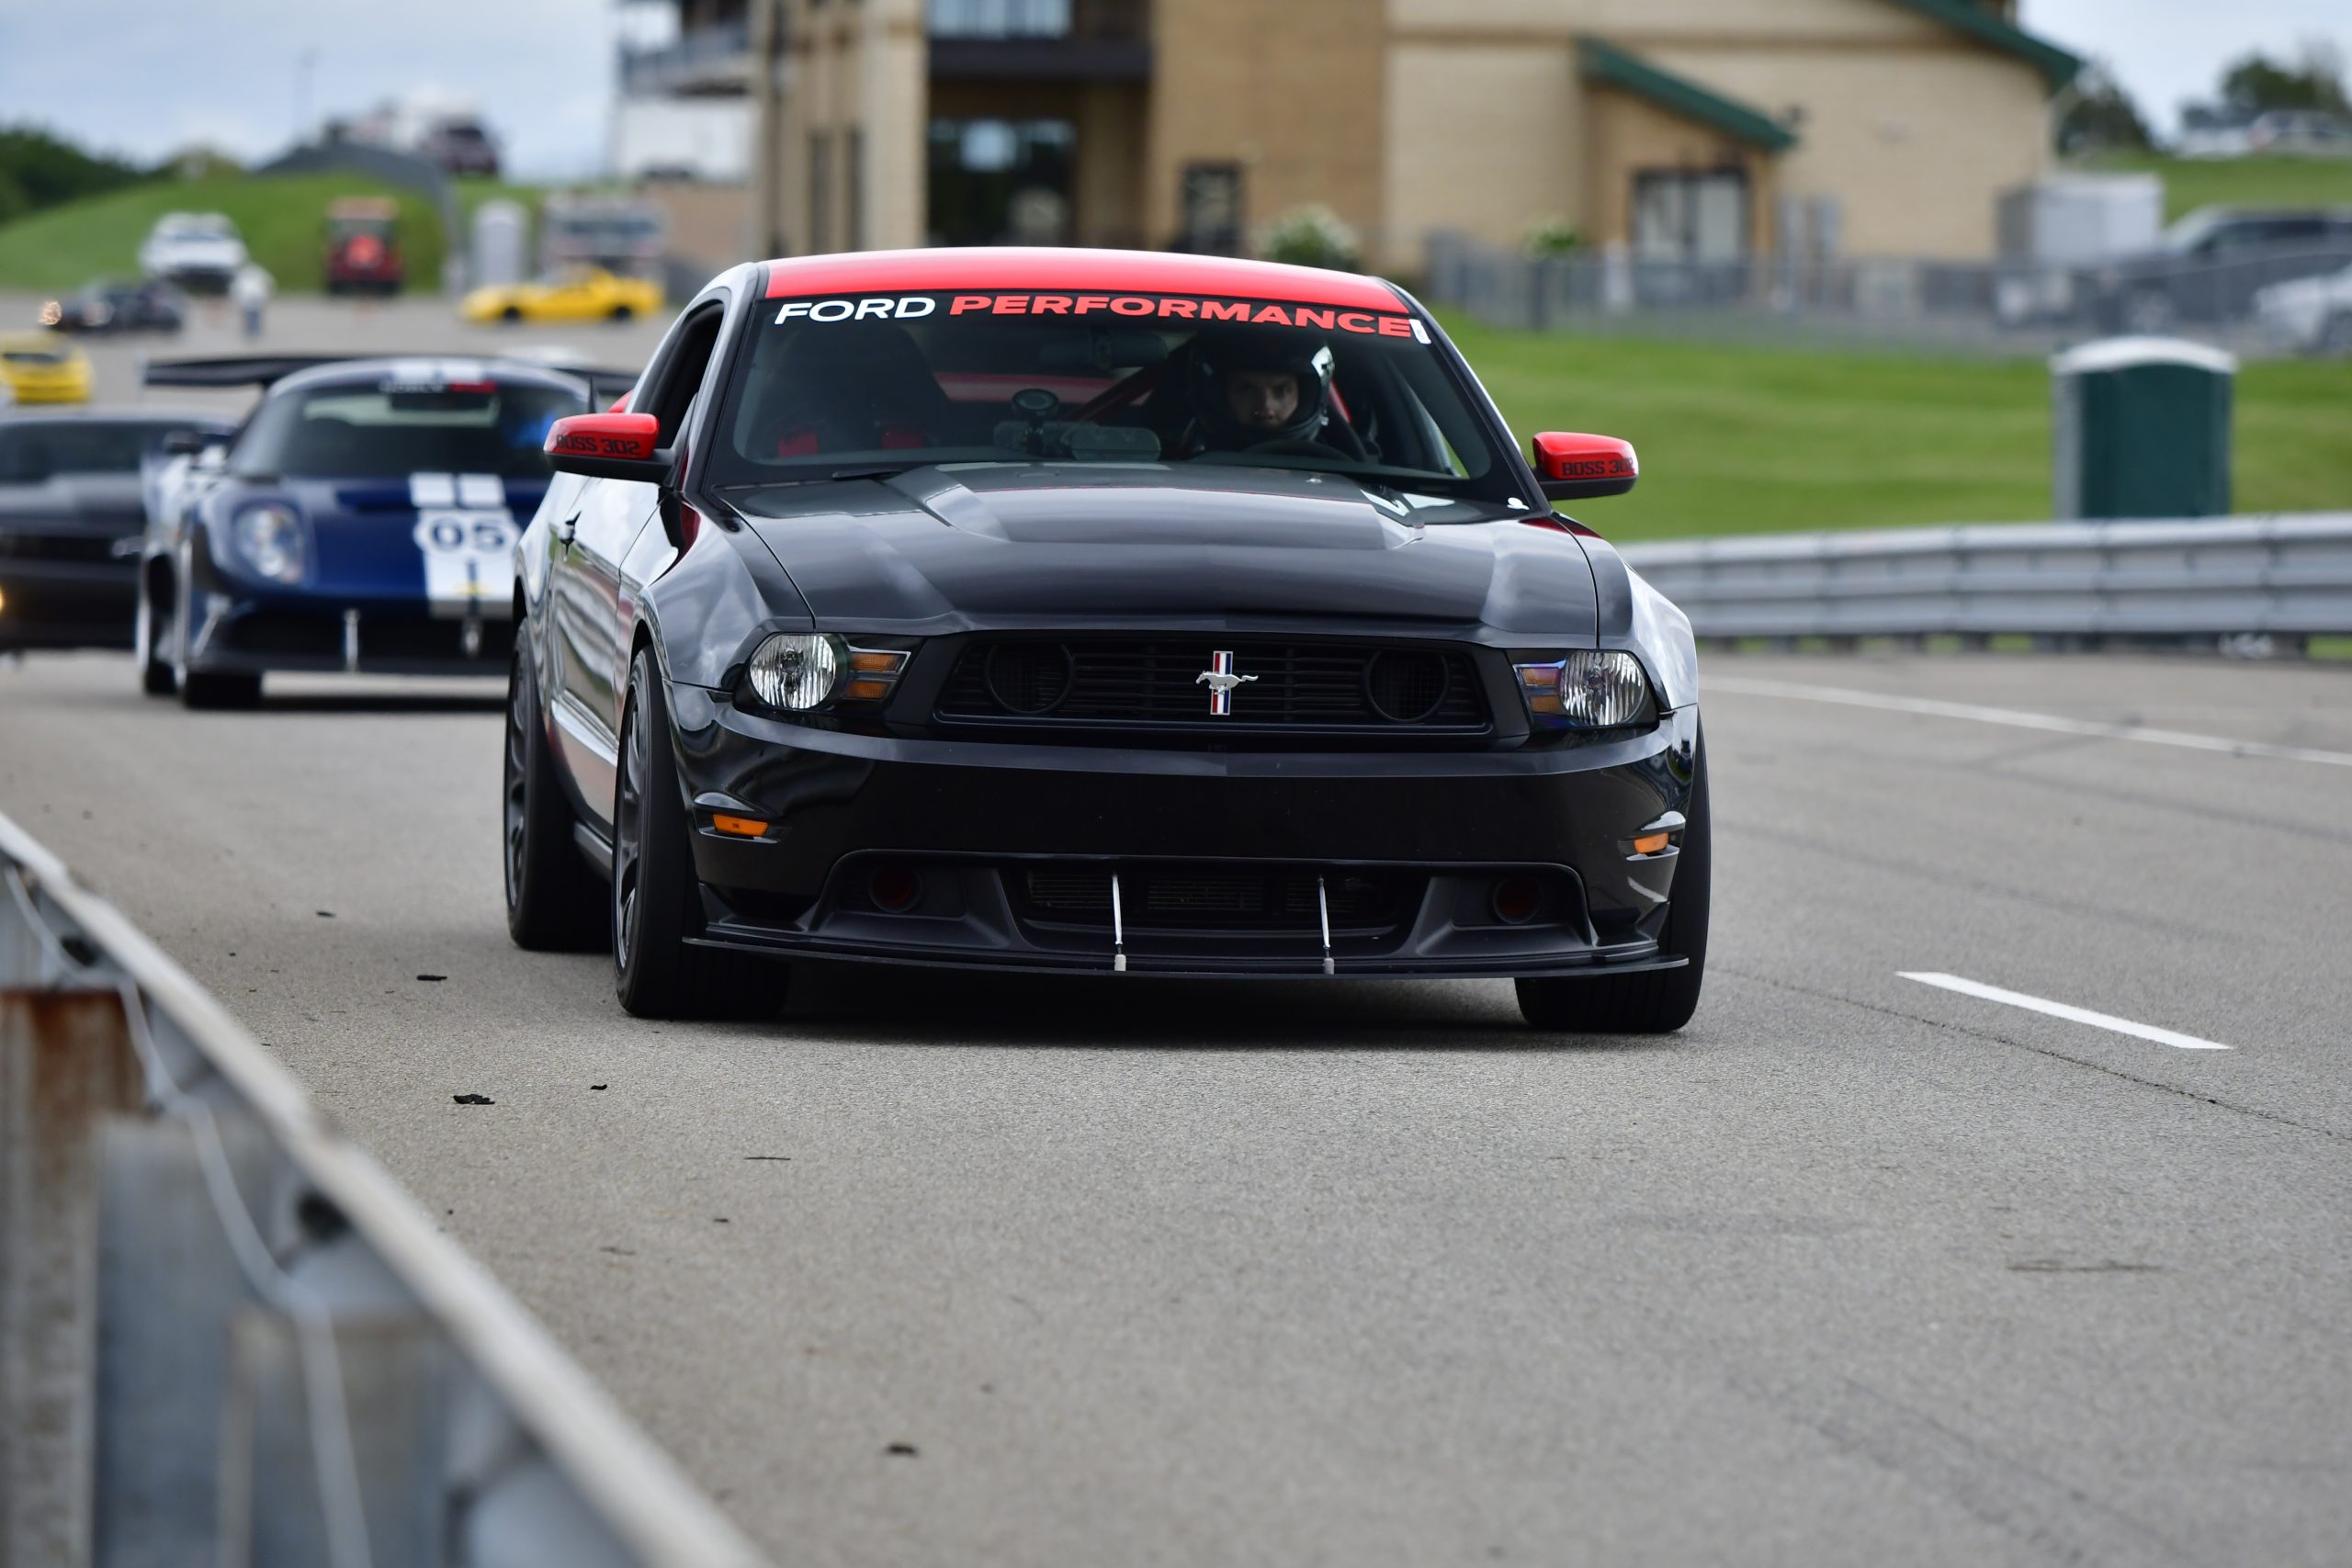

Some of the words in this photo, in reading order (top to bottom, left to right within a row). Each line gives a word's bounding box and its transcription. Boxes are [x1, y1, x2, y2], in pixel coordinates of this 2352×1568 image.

[775, 297, 935, 324] FORD
[949, 296, 1411, 338] PERFORMANCE
[556, 434, 597, 453] BOSS
[602, 438, 641, 457] 302
[1562, 461, 1606, 476] BOSS
[429, 516, 506, 553] 05
